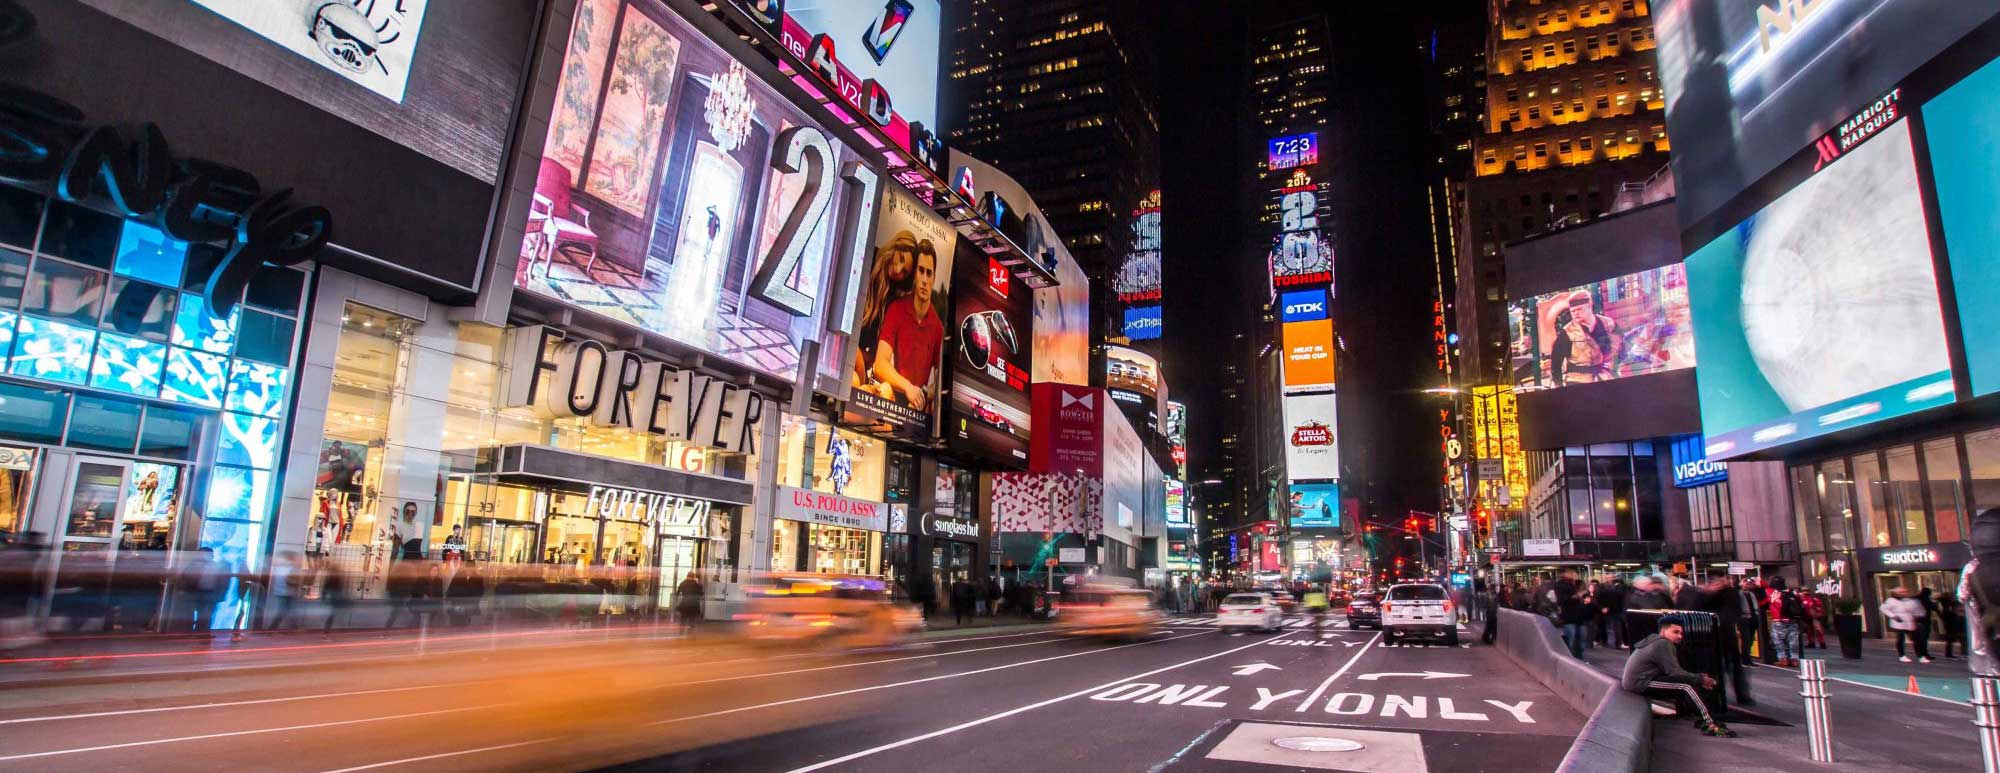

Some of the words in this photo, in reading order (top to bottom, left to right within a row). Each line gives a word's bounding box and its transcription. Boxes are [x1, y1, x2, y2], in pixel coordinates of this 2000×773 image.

[1841, 88, 1900, 137] MARRIOTT
[1841, 107, 1895, 149] MARQUIS
[1275, 138, 1310, 155] 7:23
[1286, 177, 1311, 187] 2017
[748, 126, 877, 334] 21
[1273, 272, 1332, 286] TOSHIBA
[1294, 303, 1323, 313] TDK
[1433, 301, 1446, 370] ERNST
[518, 325, 763, 455] FOREVER
[857, 392, 873, 404] LIVE
[876, 400, 927, 421] AUTHENTICALLY
[585, 486, 685, 534] FOREVER
[687, 499, 712, 538] 21
[794, 491, 815, 509] U.S.
[818, 495, 848, 513] POLO
[850, 502, 880, 518] ASSN.
[815, 513, 839, 523] SINCE
[842, 516, 861, 526] 1890
[935, 519, 966, 537] sunglass
[967, 521, 979, 537] hut
[1883, 550, 1927, 564] swatch
[1267, 639, 1364, 648] ONLY
[1089, 683, 1307, 711] ONLY
[1324, 692, 1536, 724] ONLY
